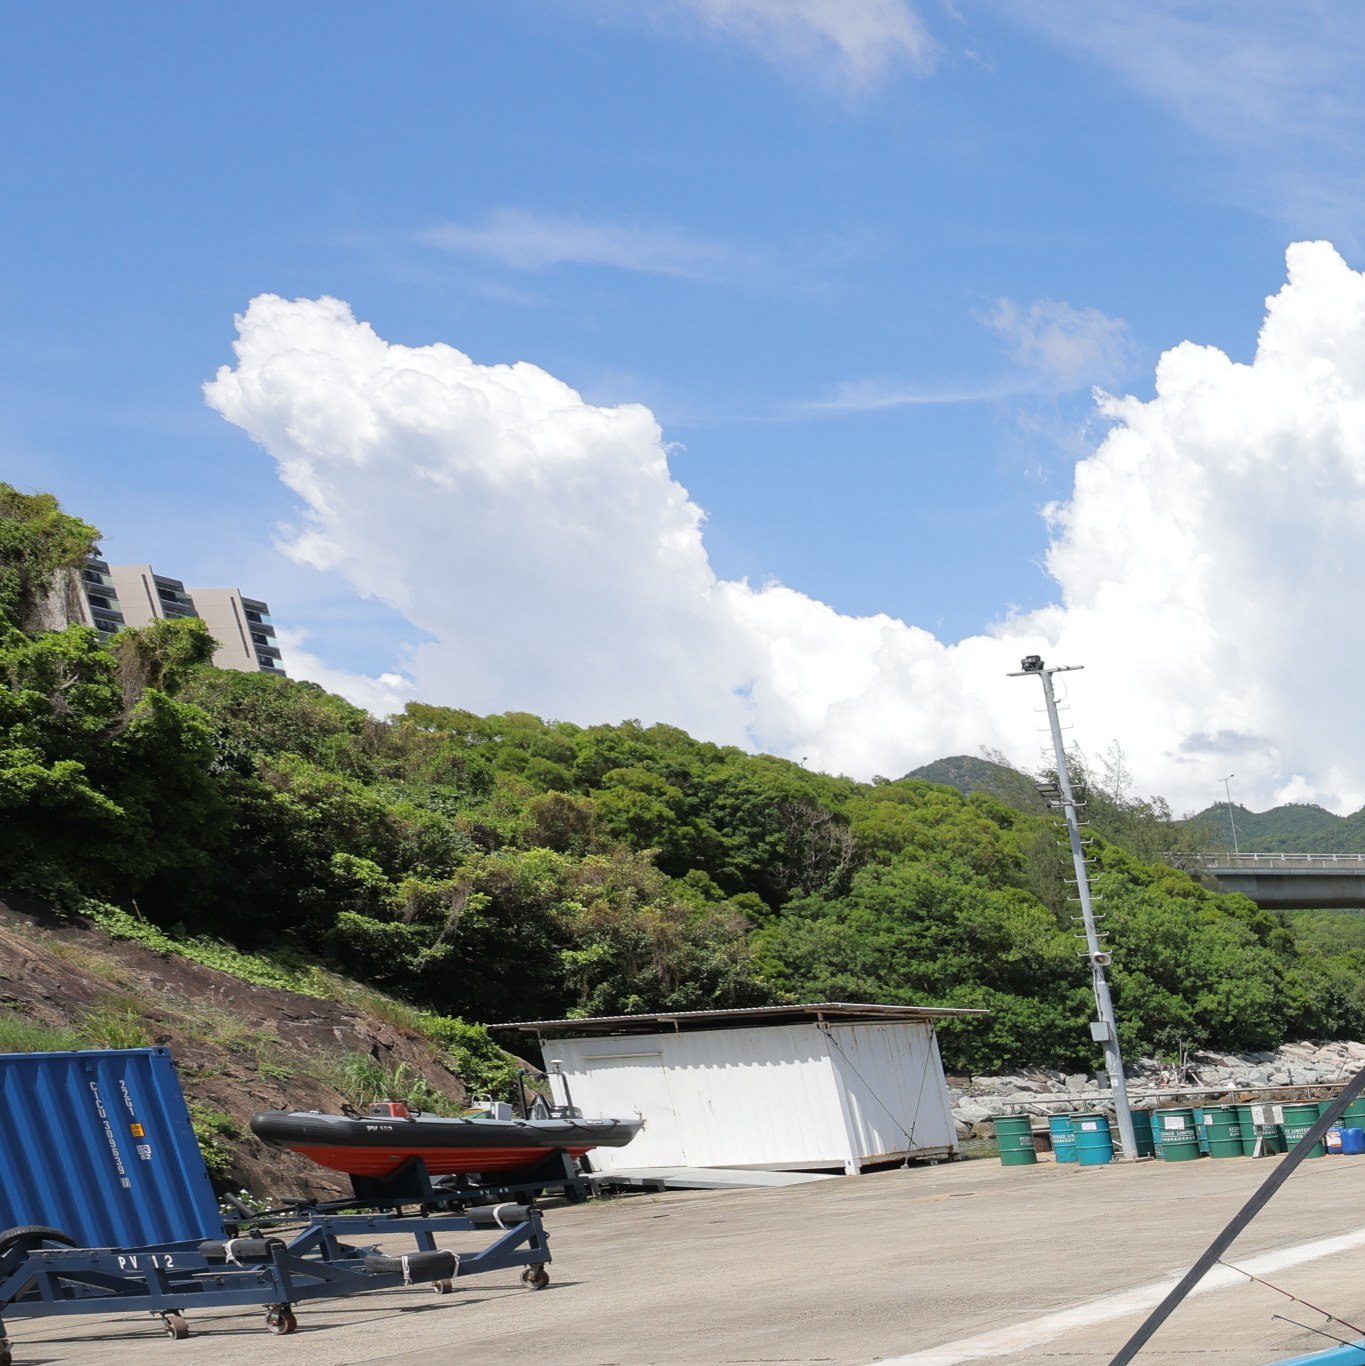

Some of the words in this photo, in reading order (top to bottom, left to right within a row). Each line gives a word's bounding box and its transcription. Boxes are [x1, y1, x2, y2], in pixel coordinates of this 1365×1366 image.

[119, 1080, 135, 1116] 22G1
[90, 1081, 107, 1119] CICU
[103, 1120, 125, 1175] 309639
[118, 1255, 138, 1270] PV
